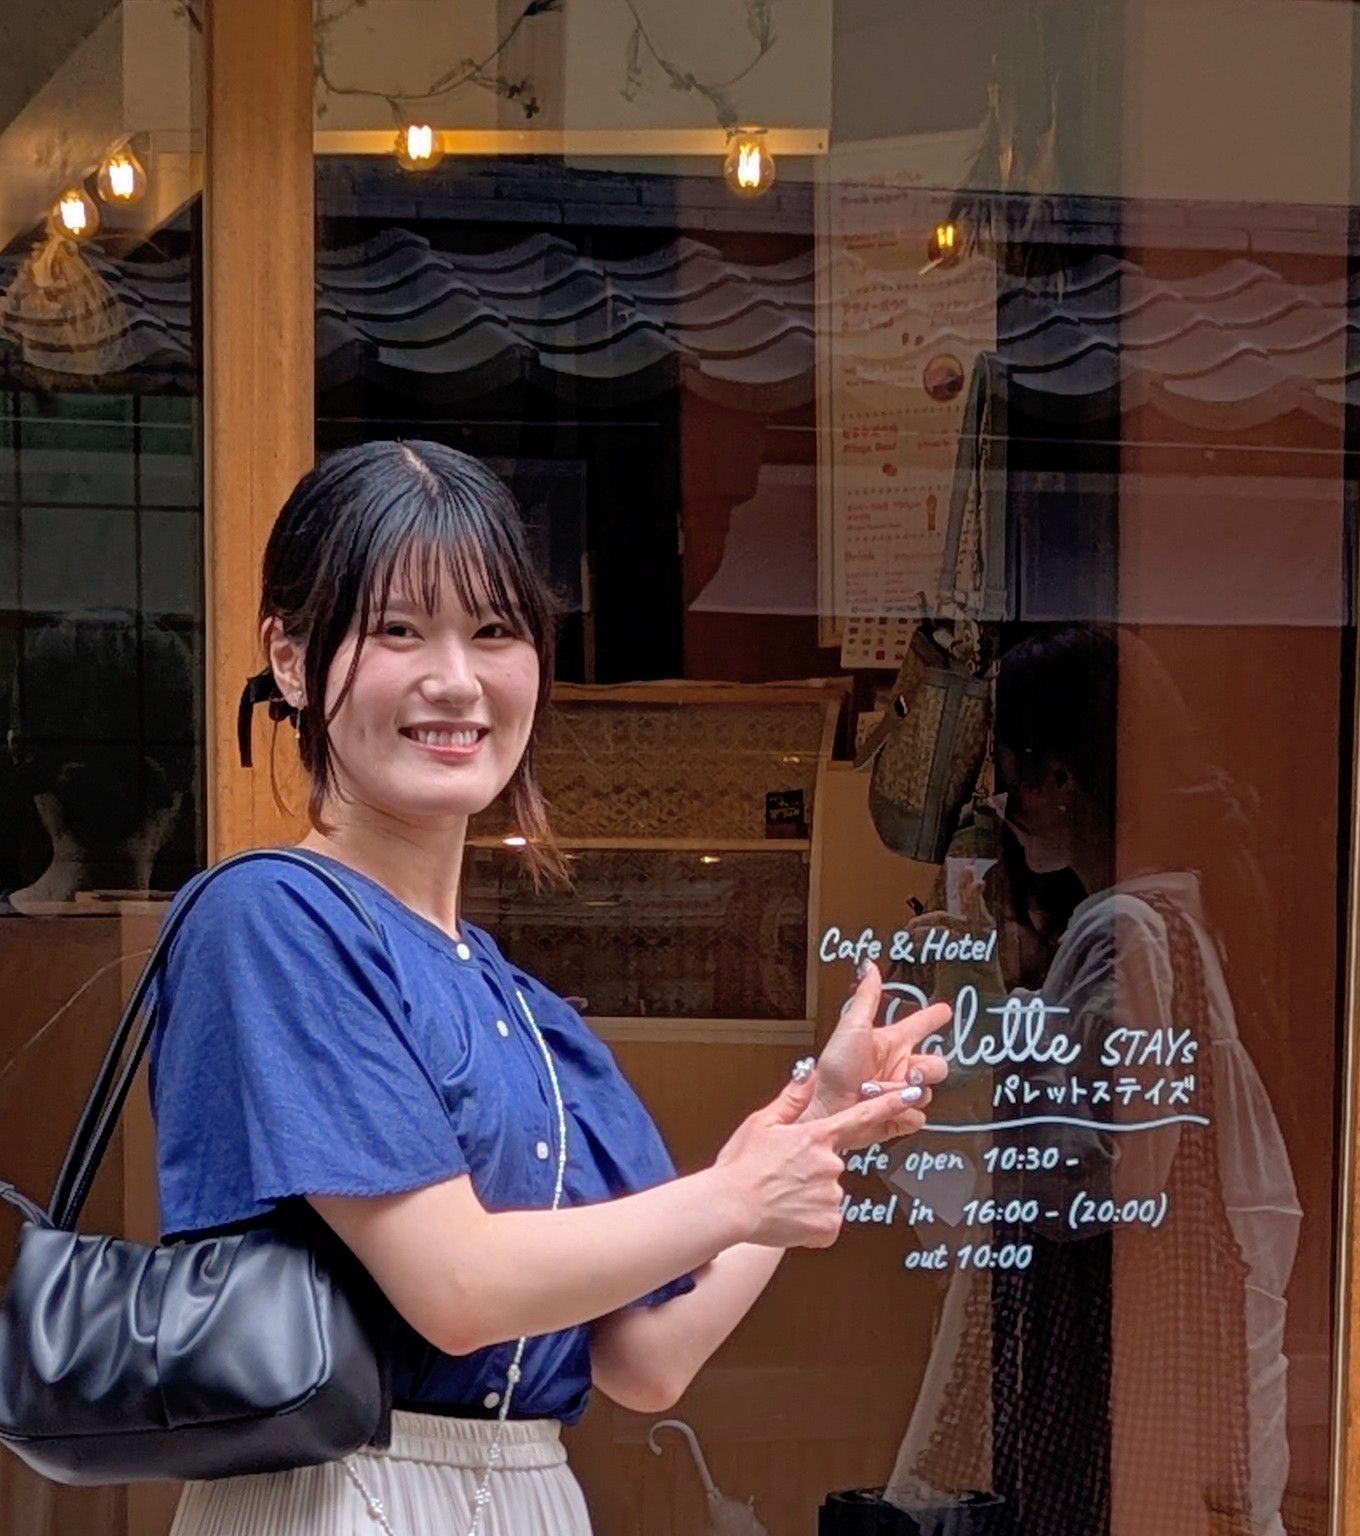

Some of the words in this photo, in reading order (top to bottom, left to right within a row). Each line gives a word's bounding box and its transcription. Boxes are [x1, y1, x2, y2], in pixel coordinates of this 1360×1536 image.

[819, 927, 882, 964] Cafe
[890, 931, 915, 963] &
[921, 929, 998, 963] Hotel
[993, 1074, 1195, 1107] パレットステイズ
[843, 1144, 889, 1175] afe
[905, 1153, 964, 1180] open
[984, 1148, 1059, 1172] 10:30
[909, 1200, 934, 1225] in
[963, 1200, 1039, 1223] 16:00
[1068, 1192, 1168, 1229] (20:00)
[905, 1246, 948, 1270] out
[957, 1245, 1033, 1270] 10:00
